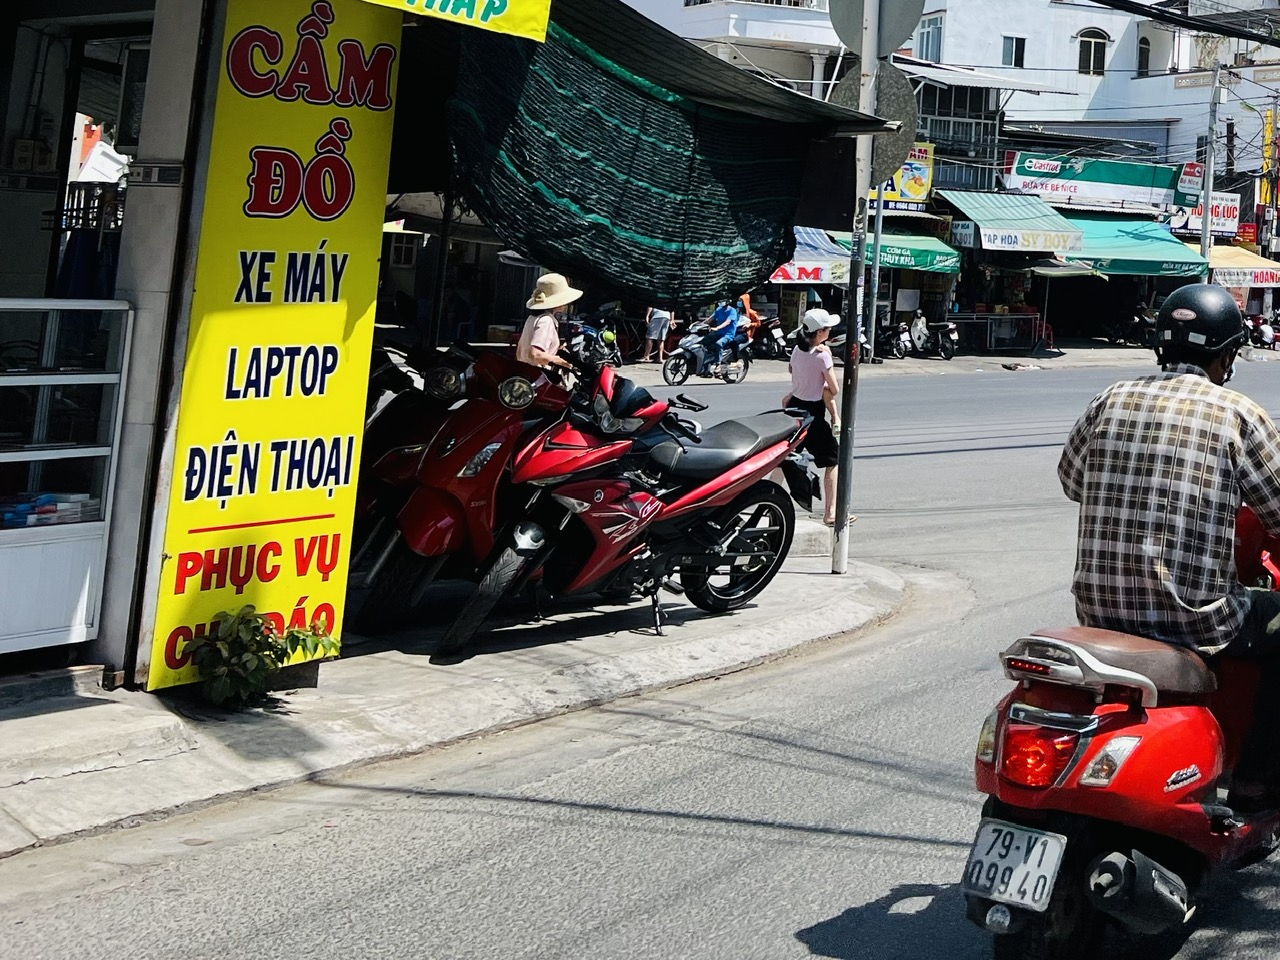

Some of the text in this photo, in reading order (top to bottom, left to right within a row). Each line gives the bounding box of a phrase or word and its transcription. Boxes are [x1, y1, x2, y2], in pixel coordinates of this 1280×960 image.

[226, 0, 397, 109] CẦM
[243, 117, 356, 221] ĐỒ
[1033, 160, 1060, 172] Castrol
[1040, 182, 1049, 191] XE
[1061, 184, 1078, 193] NICE
[234, 240, 348, 304] XE MÁY
[225, 346, 338, 401] LAPTOP
[184, 432, 355, 512] ĐIỆN THOẠI
[174, 533, 341, 595] PHỤC VỤ
[985, 828, 1048, 868] 79-V1
